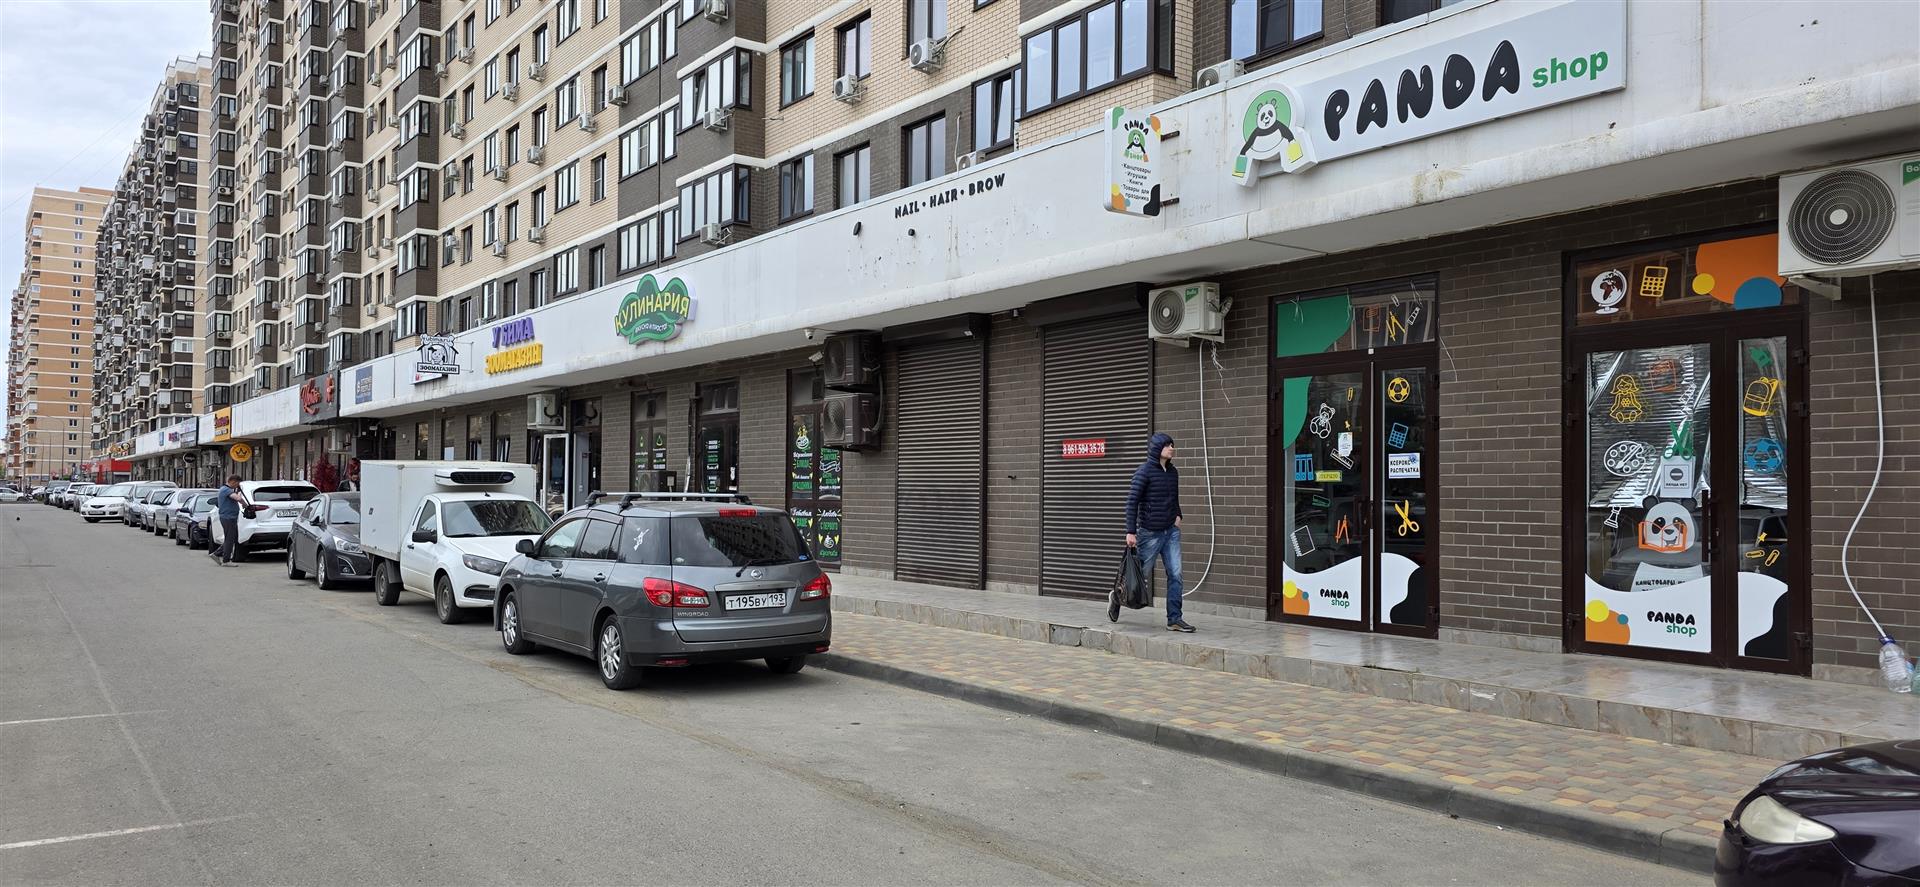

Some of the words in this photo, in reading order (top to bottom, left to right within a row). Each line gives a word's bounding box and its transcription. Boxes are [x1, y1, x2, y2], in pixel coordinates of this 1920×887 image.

[1324, 40, 1521, 141] PANDA
[1532, 50, 1609, 88] shop
[1124, 120, 1149, 135] PANDA
[1906, 164, 1920, 173] Ba
[895, 201, 920, 219] NAIL
[930, 189, 958, 209] HAIR
[969, 173, 1006, 197] BROW
[614, 292, 690, 334] КУЛИНАРИЯ
[485, 343, 543, 376] ЗООМАГАЗИН
[420, 365, 457, 373] ЗООМАГАЗИН
[769, 593, 784, 603] 193
[1320, 588, 1349, 600] PANDA
[1331, 597, 1350, 609] shop
[1647, 610, 1695, 626] PANDA
[1666, 622, 1697, 637] shop
